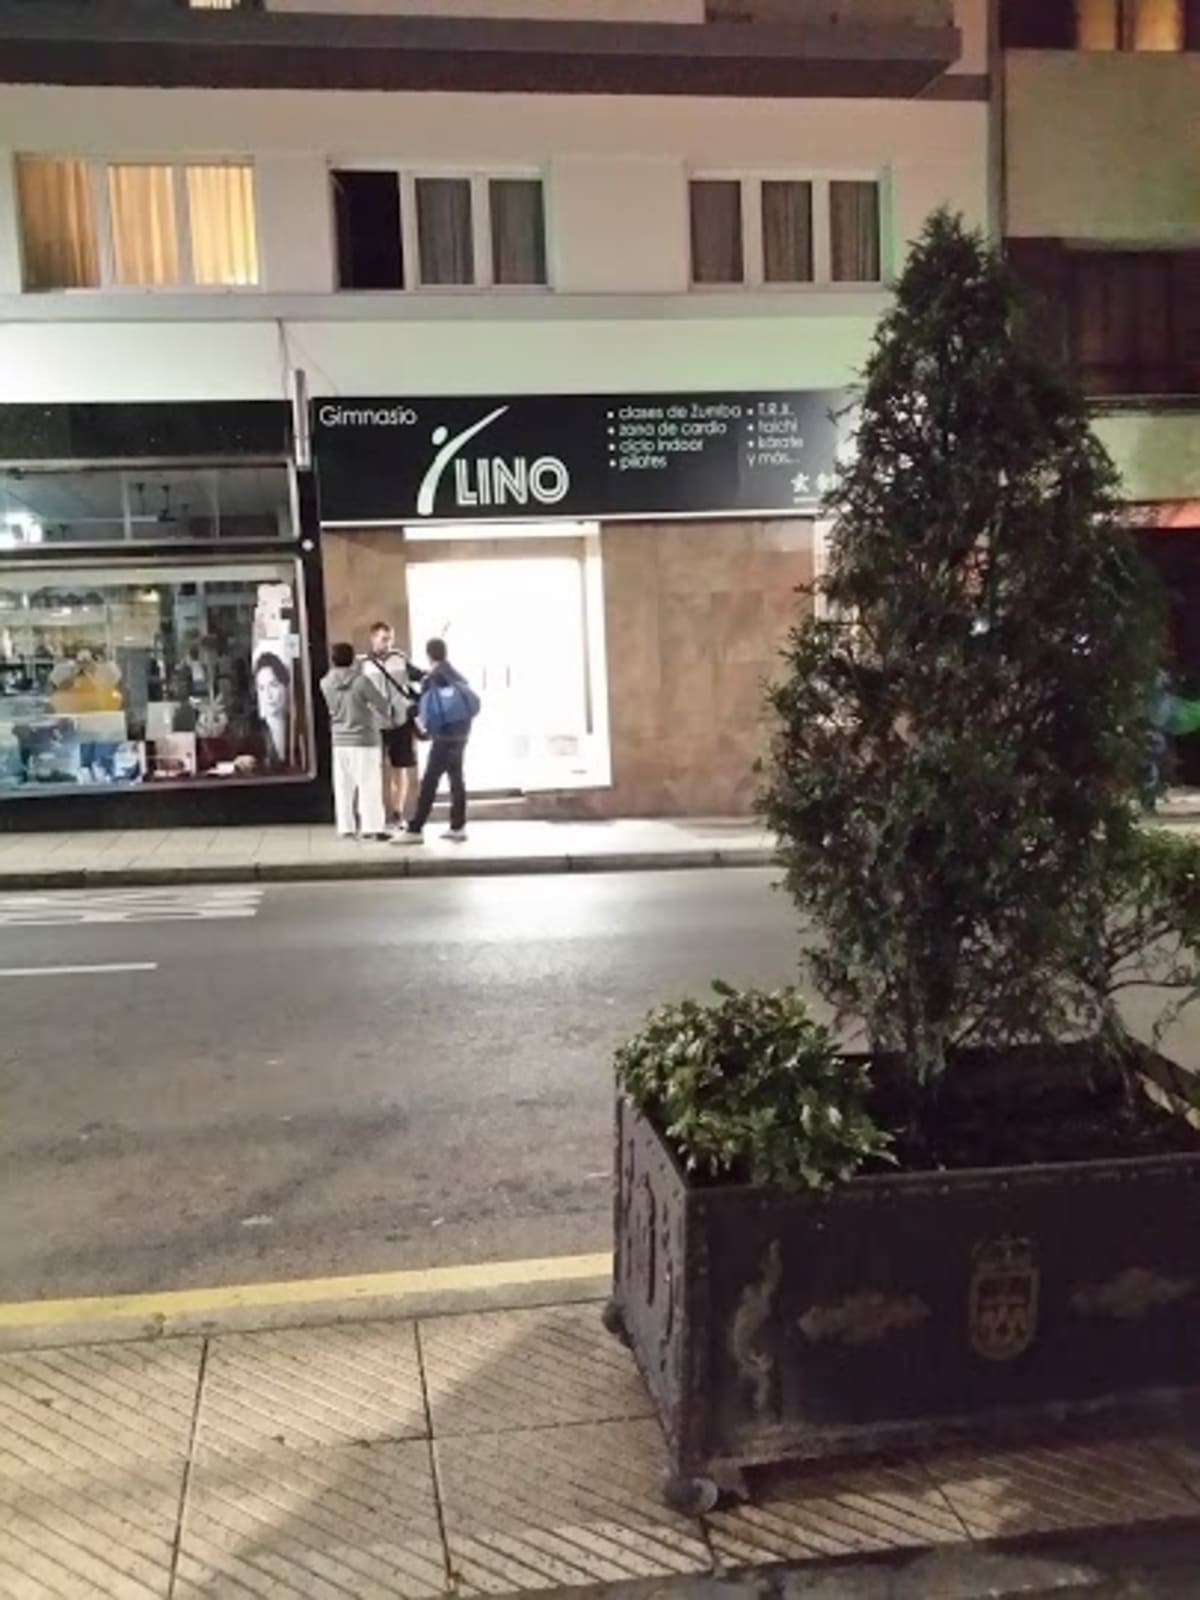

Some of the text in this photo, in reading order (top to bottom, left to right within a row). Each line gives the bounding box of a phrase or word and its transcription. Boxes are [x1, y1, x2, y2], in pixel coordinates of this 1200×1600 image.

[319, 405, 417, 427] Gimnasio
[657, 421, 678, 436] de
[681, 420, 727, 435] cardio
[619, 454, 668, 471] pilates
[746, 453, 756, 467] y
[455, 456, 569, 506] LINO
